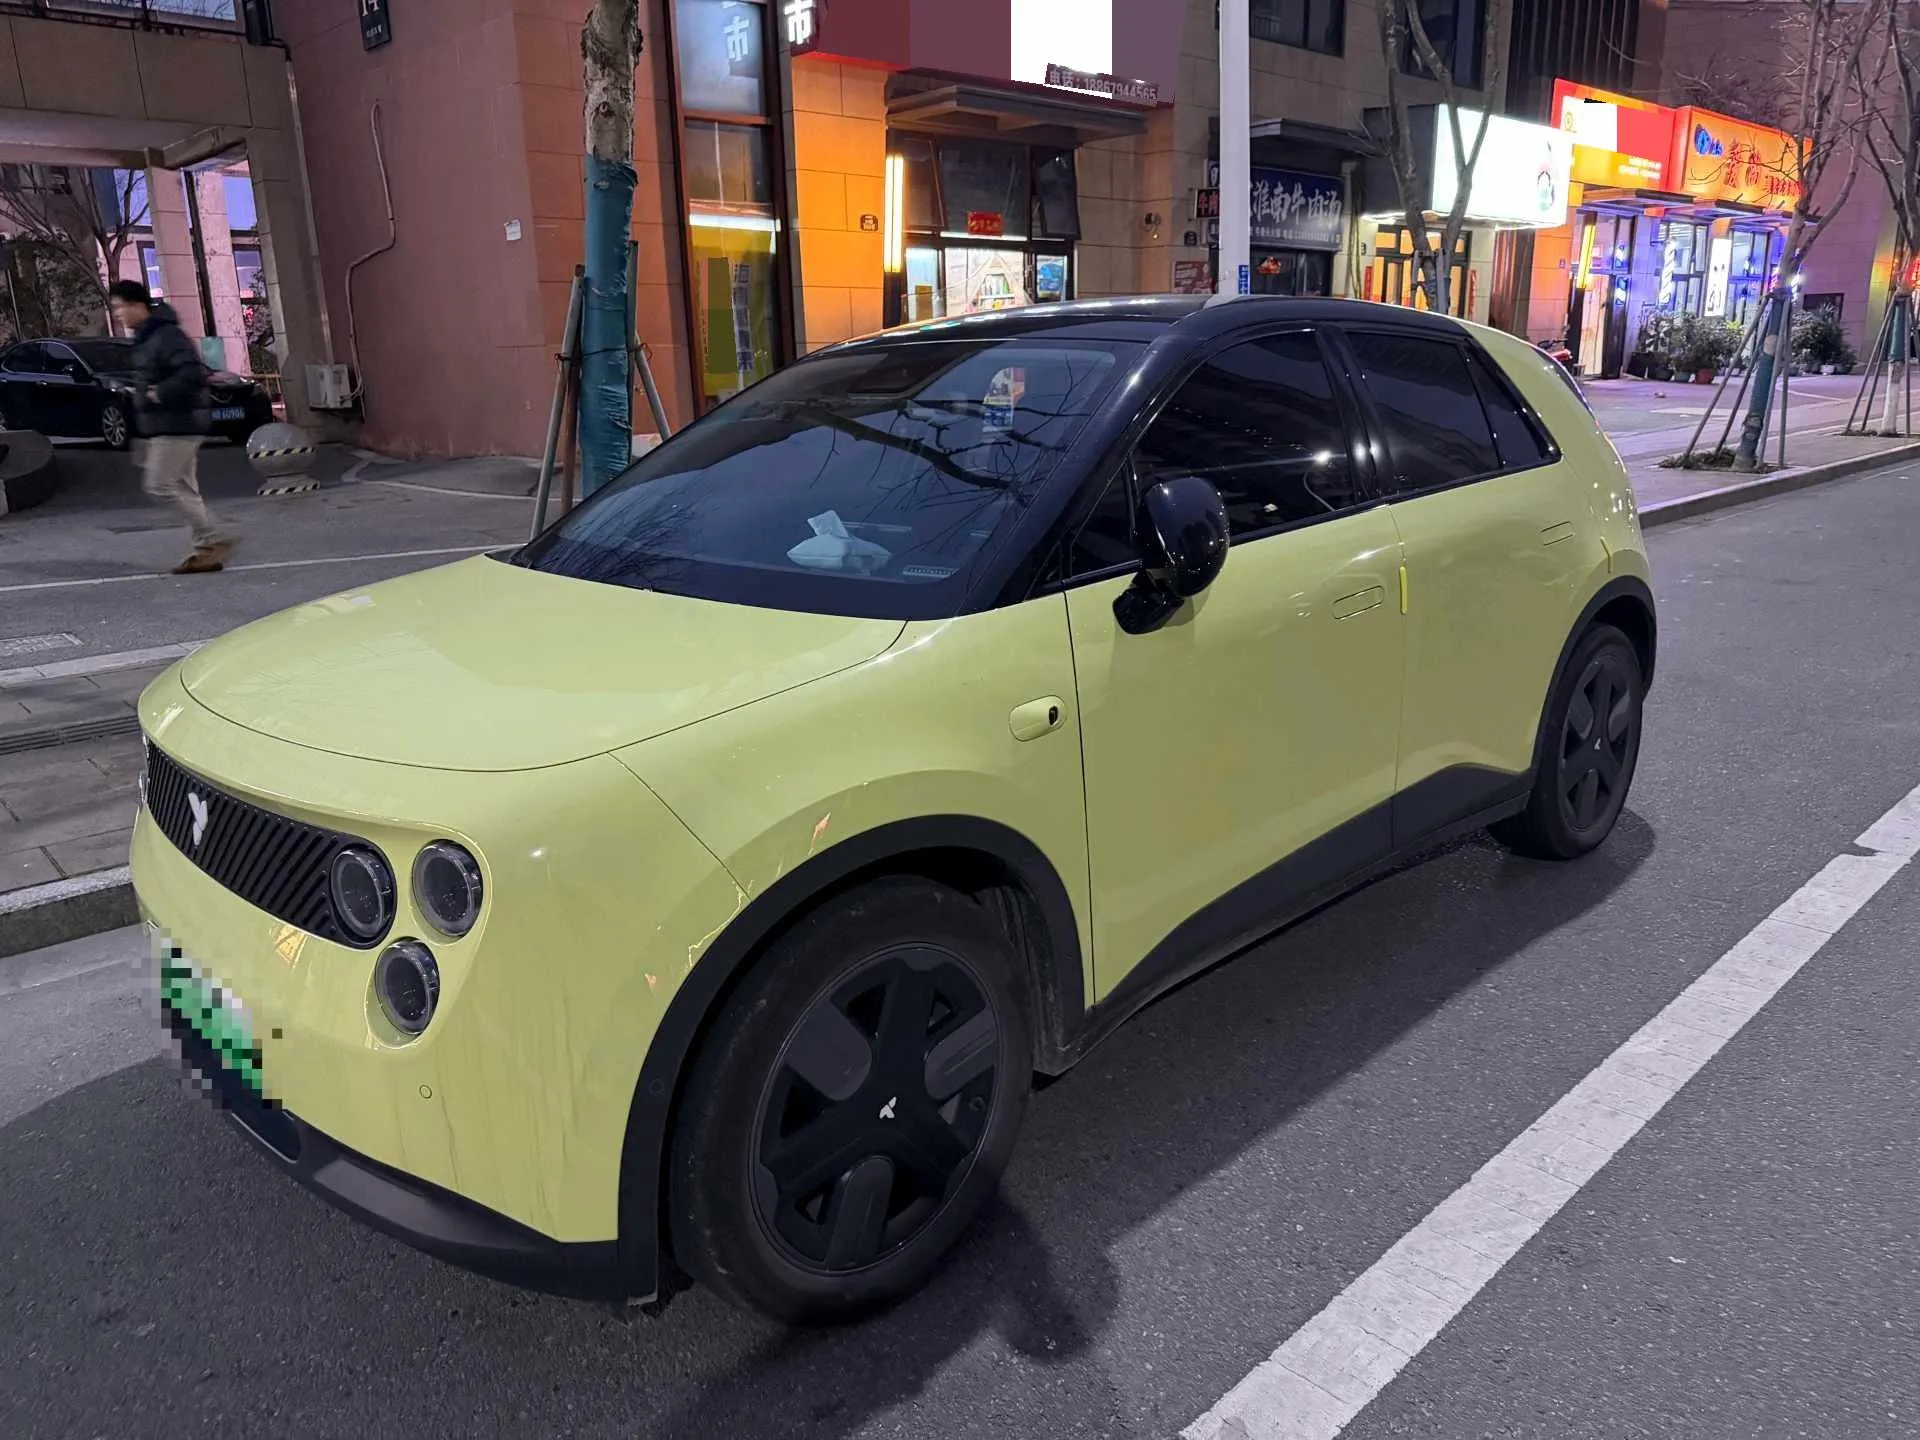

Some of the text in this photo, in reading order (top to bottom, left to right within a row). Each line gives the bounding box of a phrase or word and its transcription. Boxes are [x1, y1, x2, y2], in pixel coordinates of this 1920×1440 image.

[1250, 178, 1342, 227] 淮南牛肉汤
